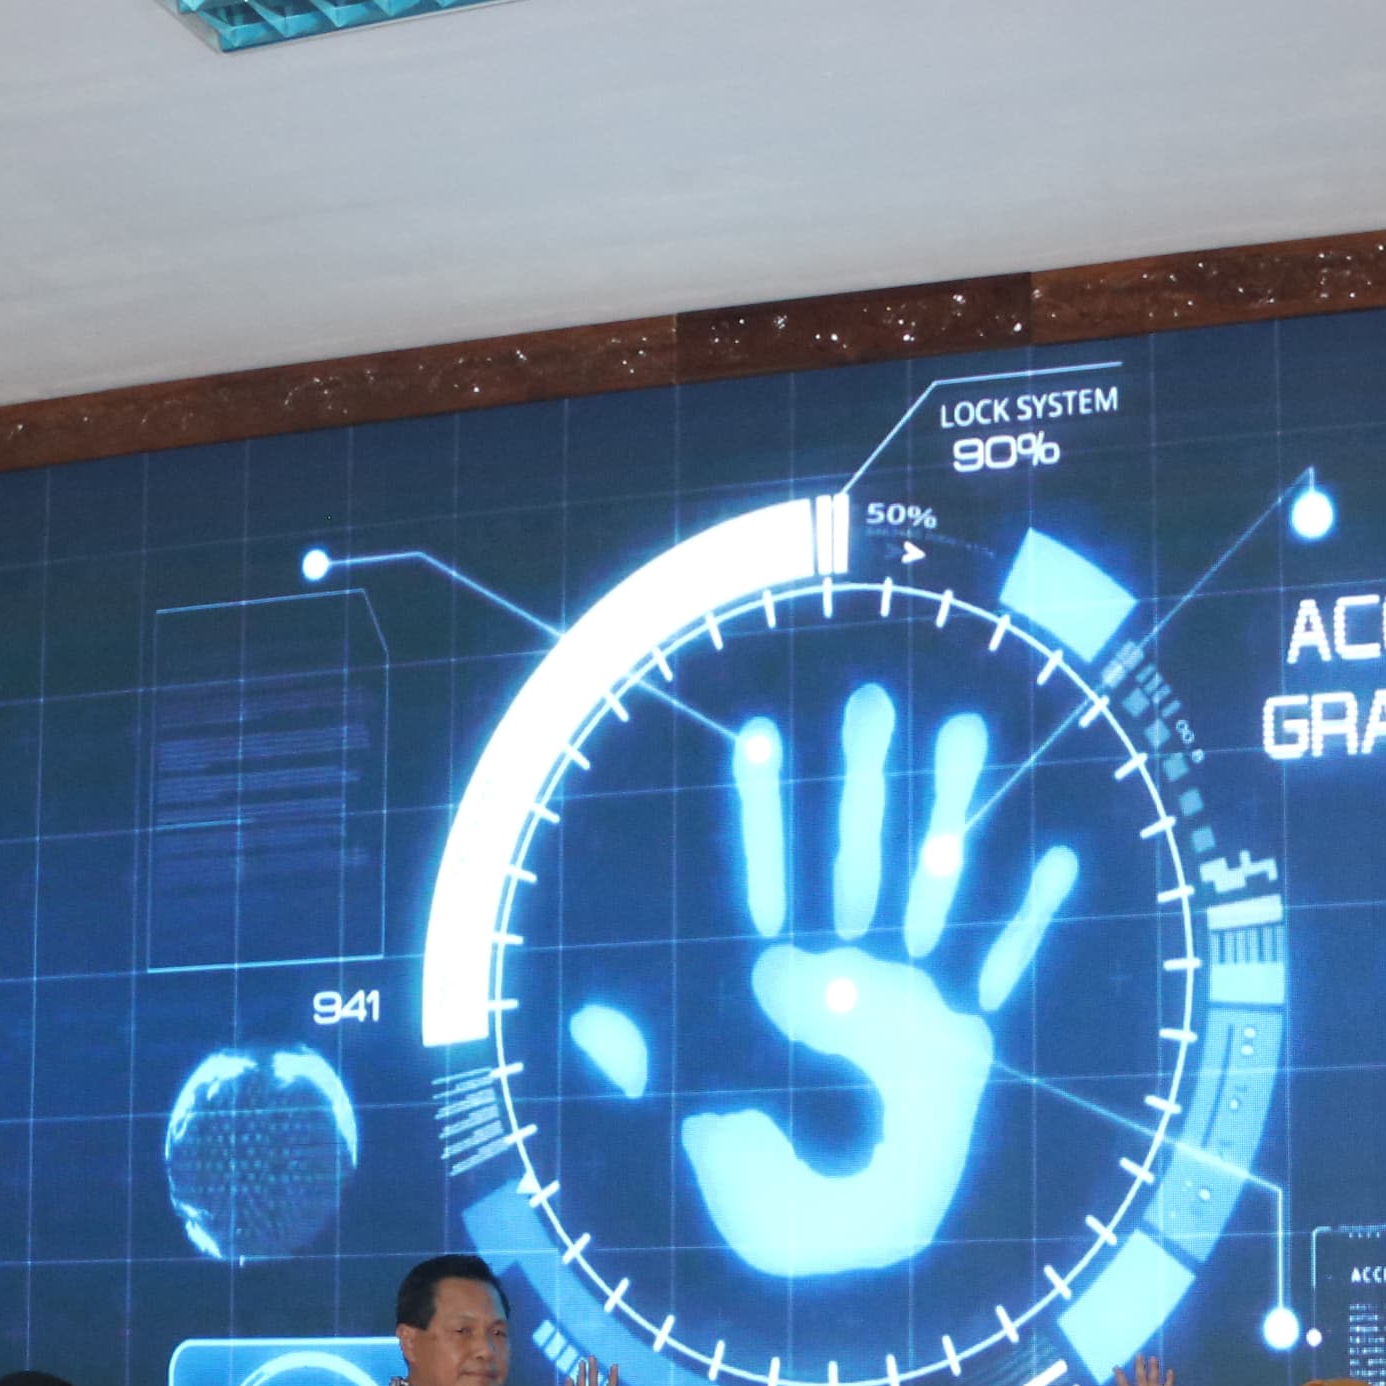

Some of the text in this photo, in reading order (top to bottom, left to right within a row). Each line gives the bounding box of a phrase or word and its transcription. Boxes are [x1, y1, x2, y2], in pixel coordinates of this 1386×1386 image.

[941, 386, 1119, 428] LOCK SYSTEM
[953, 431, 1060, 472] 90%
[866, 502, 938, 529] 50%
[313, 989, 380, 1025] 941
